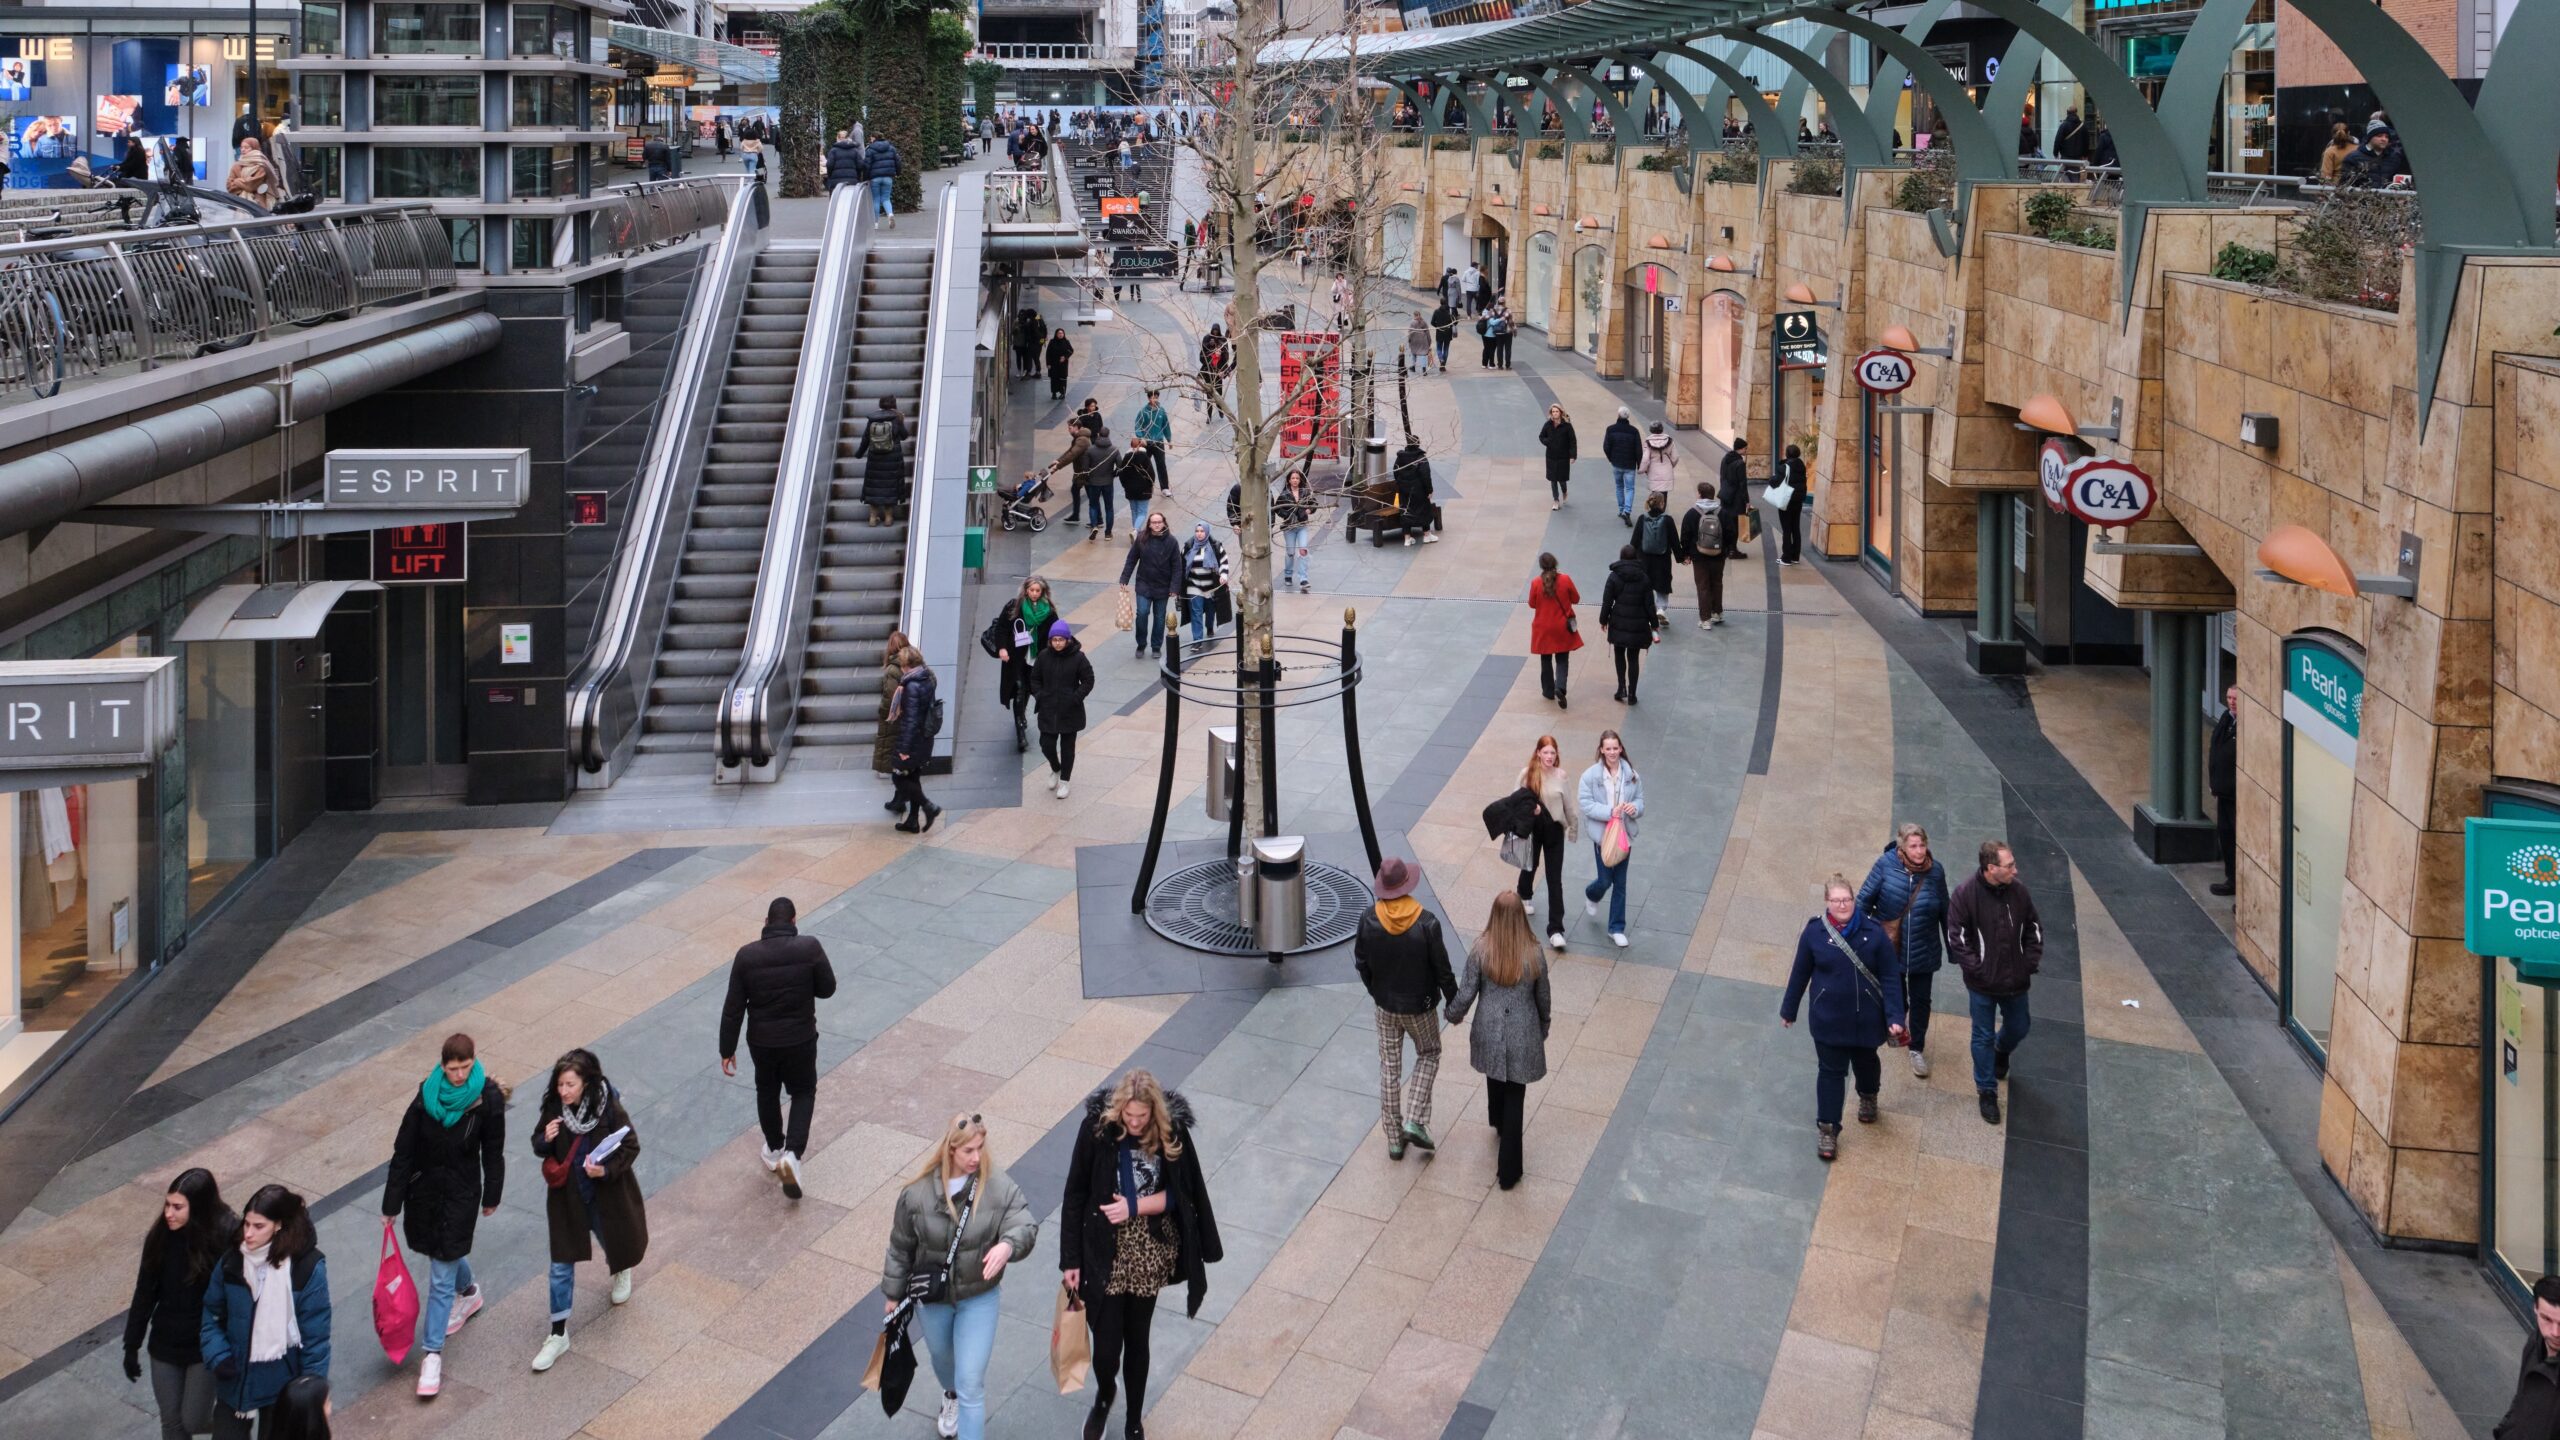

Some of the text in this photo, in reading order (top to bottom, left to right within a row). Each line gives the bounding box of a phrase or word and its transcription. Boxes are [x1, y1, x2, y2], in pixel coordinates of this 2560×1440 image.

[20, 38, 73, 60] WE
[223, 38, 275, 61] WE
[1099, 189, 1115, 197] WE
[1112, 227, 1149, 235] SWAROVSKI
[1538, 244, 1552, 254] ZARA
[1120, 257, 1164, 267] DOUGLAS
[1666, 299, 1674, 310] P
[1865, 361, 1906, 383] C&A
[339, 469, 509, 493] ESPRIT
[2080, 478, 2141, 510] C&A
[391, 554, 446, 574] LIFT
[2302, 654, 2347, 709] Pearle
[9, 700, 131, 740] RIT
[2484, 888, 2560, 924] Pea
[2514, 927, 2560, 940] opticie
